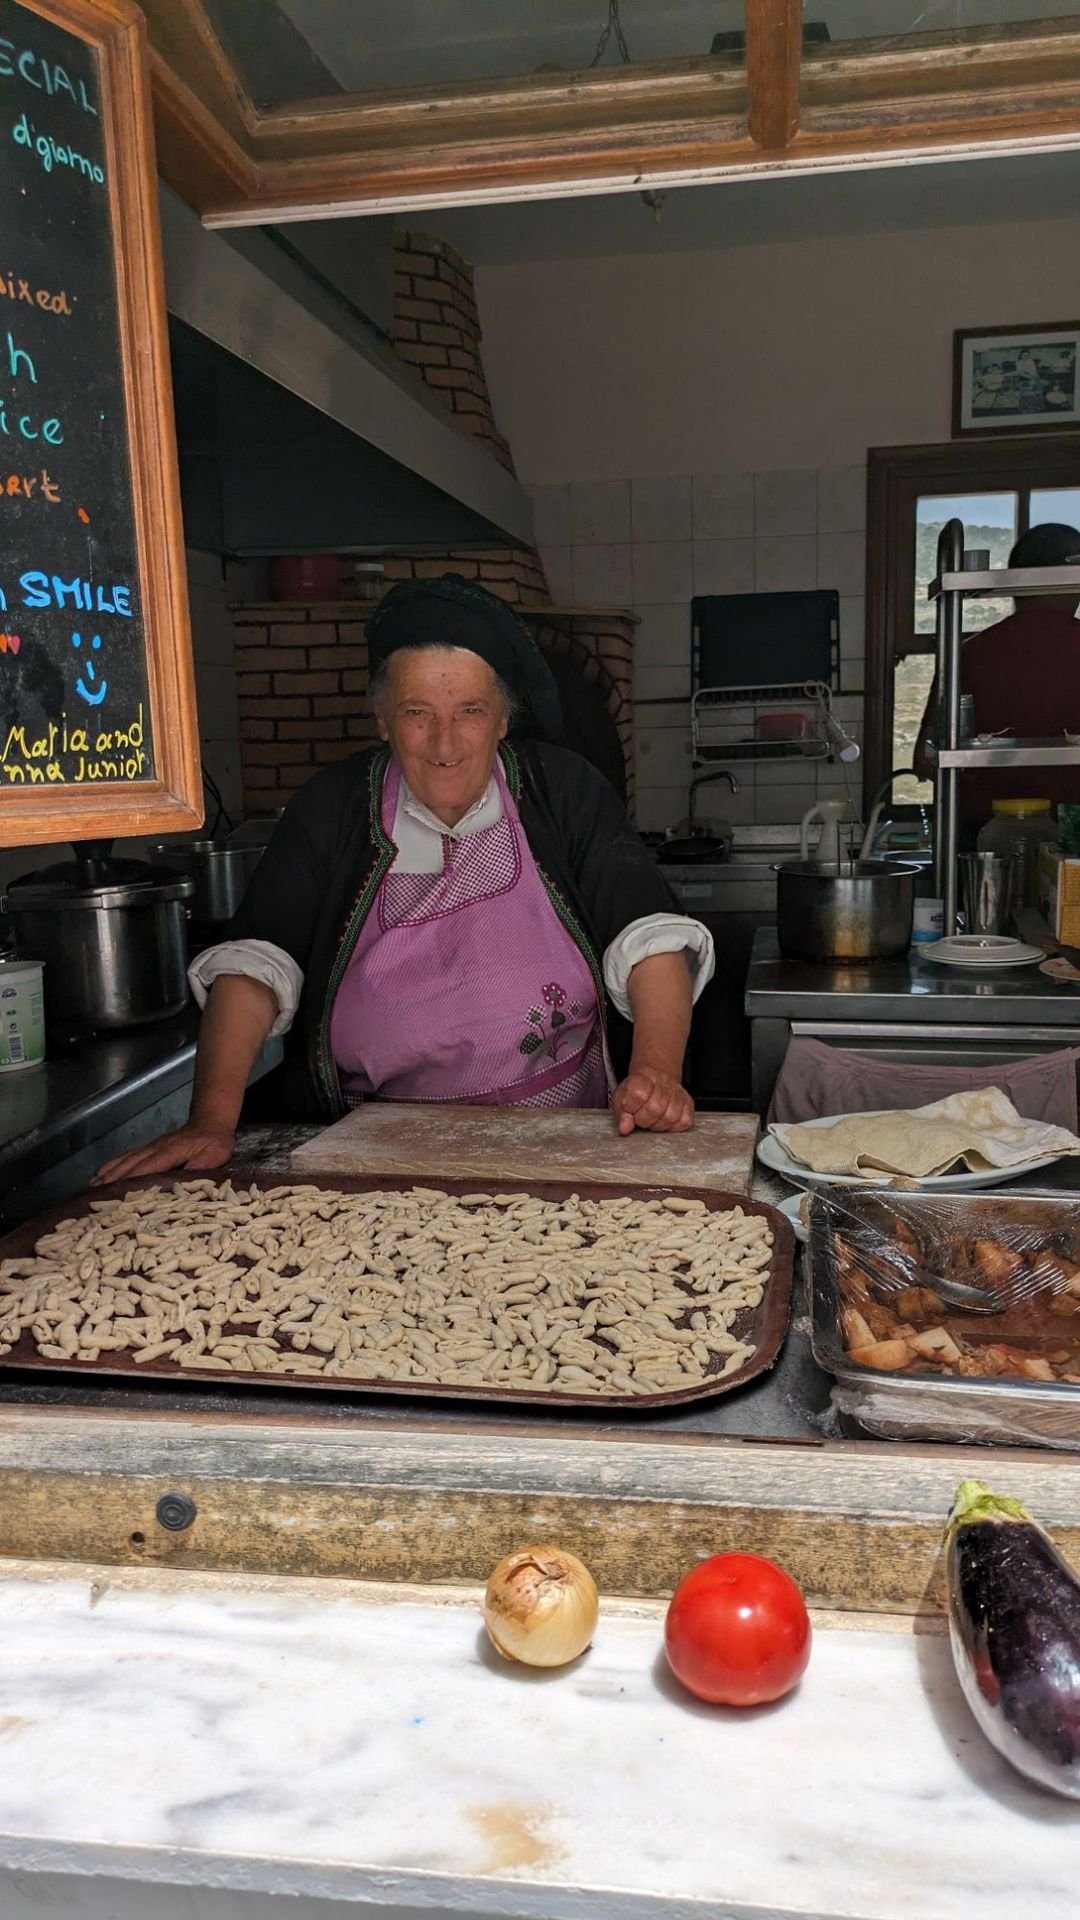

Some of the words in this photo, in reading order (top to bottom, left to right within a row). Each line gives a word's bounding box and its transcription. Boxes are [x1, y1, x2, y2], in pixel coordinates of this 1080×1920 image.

[0, 38, 98, 116] ECIAL
[20, 571, 133, 617] SMILE
[1, 712, 89, 763] Maria
[95, 702, 143, 752] and
